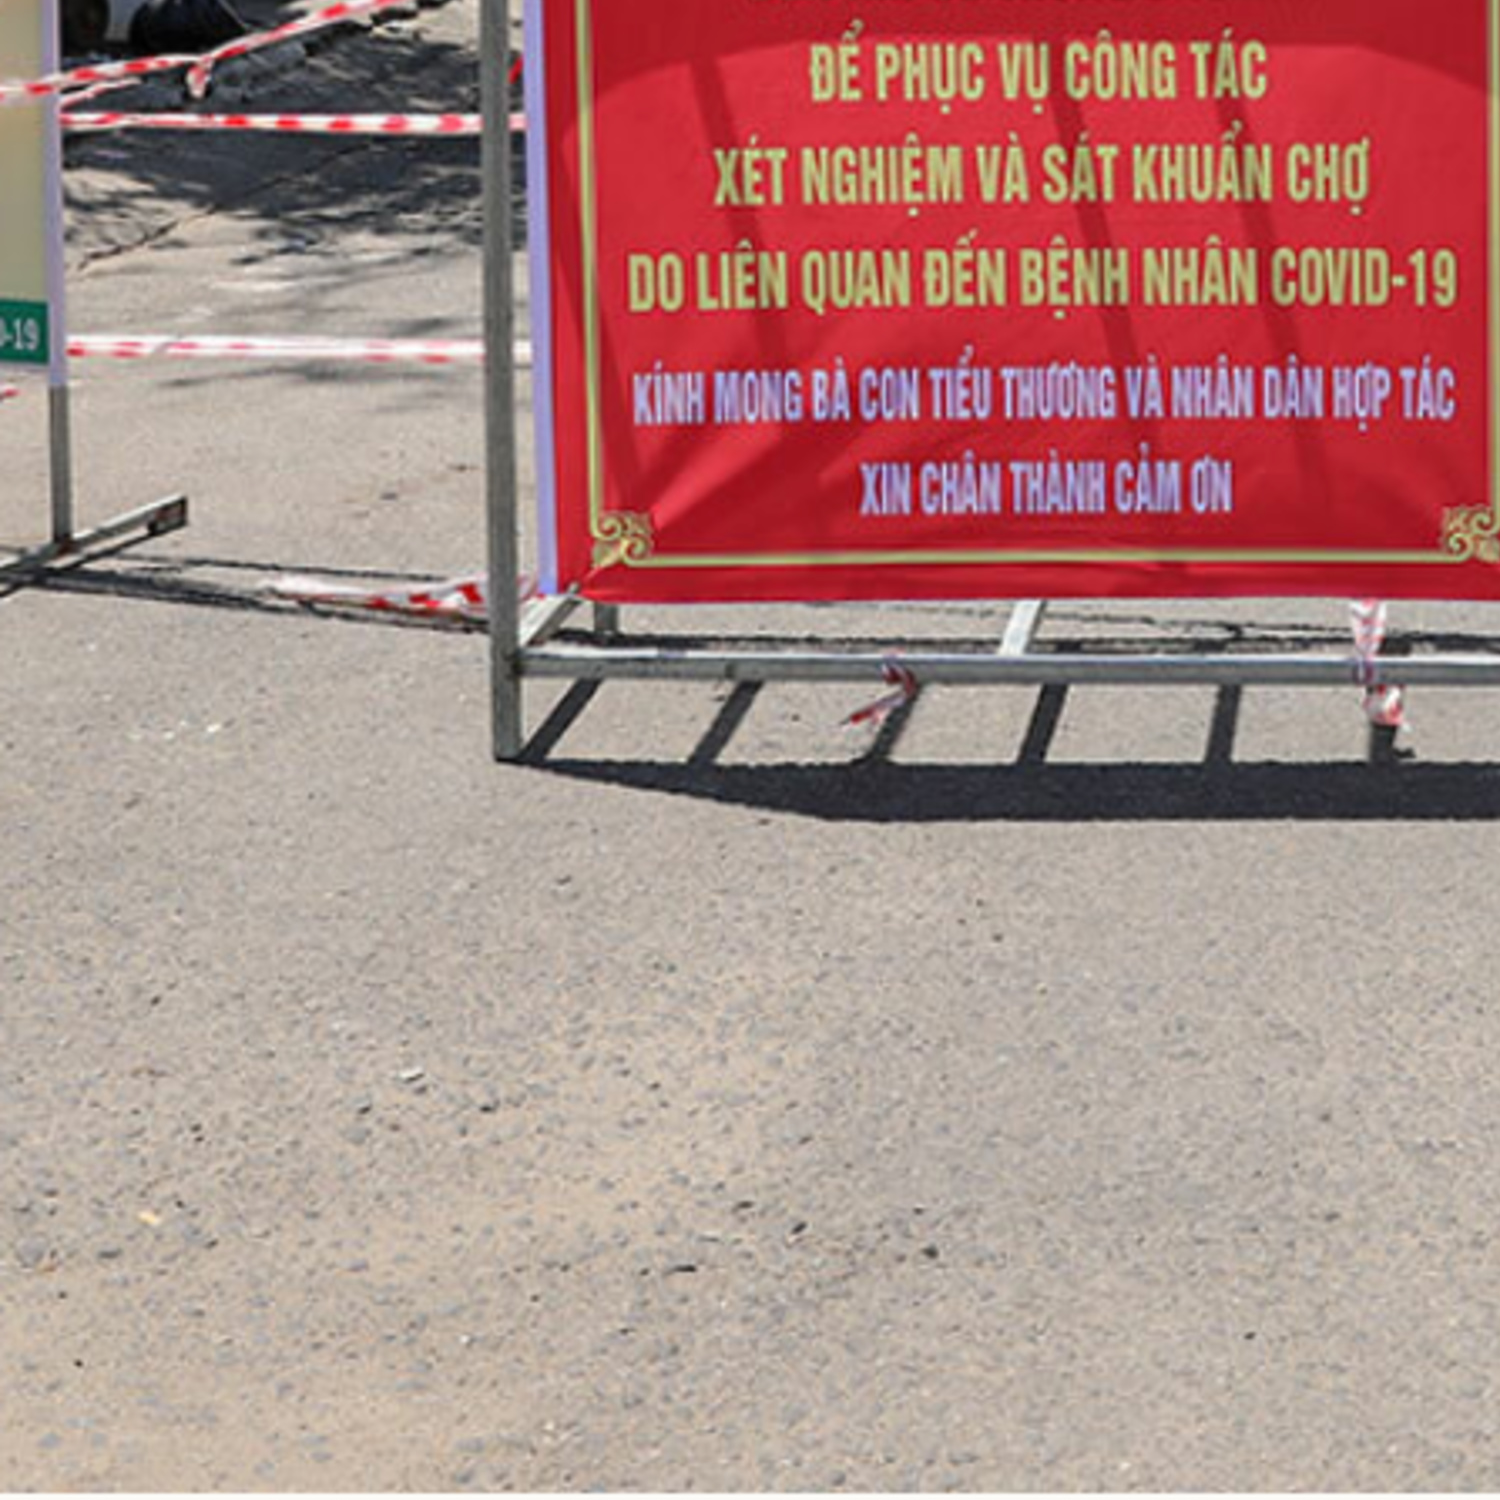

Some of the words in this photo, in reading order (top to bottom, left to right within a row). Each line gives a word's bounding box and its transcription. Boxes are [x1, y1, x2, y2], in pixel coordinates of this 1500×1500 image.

[809, 19, 863, 102] ĐỂ
[875, 42, 985, 115] PHỤC
[997, 42, 1049, 114] VỤ
[1065, 29, 1177, 101] CÔNG
[1189, 28, 1267, 100] TÁC
[714, 134, 788, 206] XÉT
[801, 132, 963, 217] NGHIỆM
[975, 131, 1029, 203] VÀ
[1042, 133, 1119, 203] SÁT
[1132, 120, 1272, 203] KHUẨN
[1287, 137, 1370, 215] CHỢ
[629, 253, 684, 312] DO
[696, 239, 788, 311] LIÊN
[802, 249, 911, 316] QUAN
[923, 230, 1006, 306] ĐẾN
[1020, 235, 1129, 320] BỆNH
[1143, 234, 1257, 305] NHÂN
[1272, 247, 1456, 307] COVID-19
[633, 361, 704, 425] KÍNH
[714, 369, 803, 424] MONG
[811, 356, 851, 421] BÀ
[859, 367, 920, 421] CON
[928, 344, 991, 420] TIỂU
[999, 361, 1116, 420] THƯƠNG
[1124, 354, 1164, 418] VÀ
[1171, 354, 1254, 419] NHÂN
[1263, 354, 1324, 419] DÂN
[1332, 362, 1391, 431] HỢP
[1399, 355, 1455, 420] TÁC
[860, 462, 911, 515] XIN
[920, 450, 1001, 515] CHÂN
[1009, 449, 1106, 514] THÀNH
[1114, 442, 1182, 514] CẢM
[1191, 455, 1232, 514] ƠN
